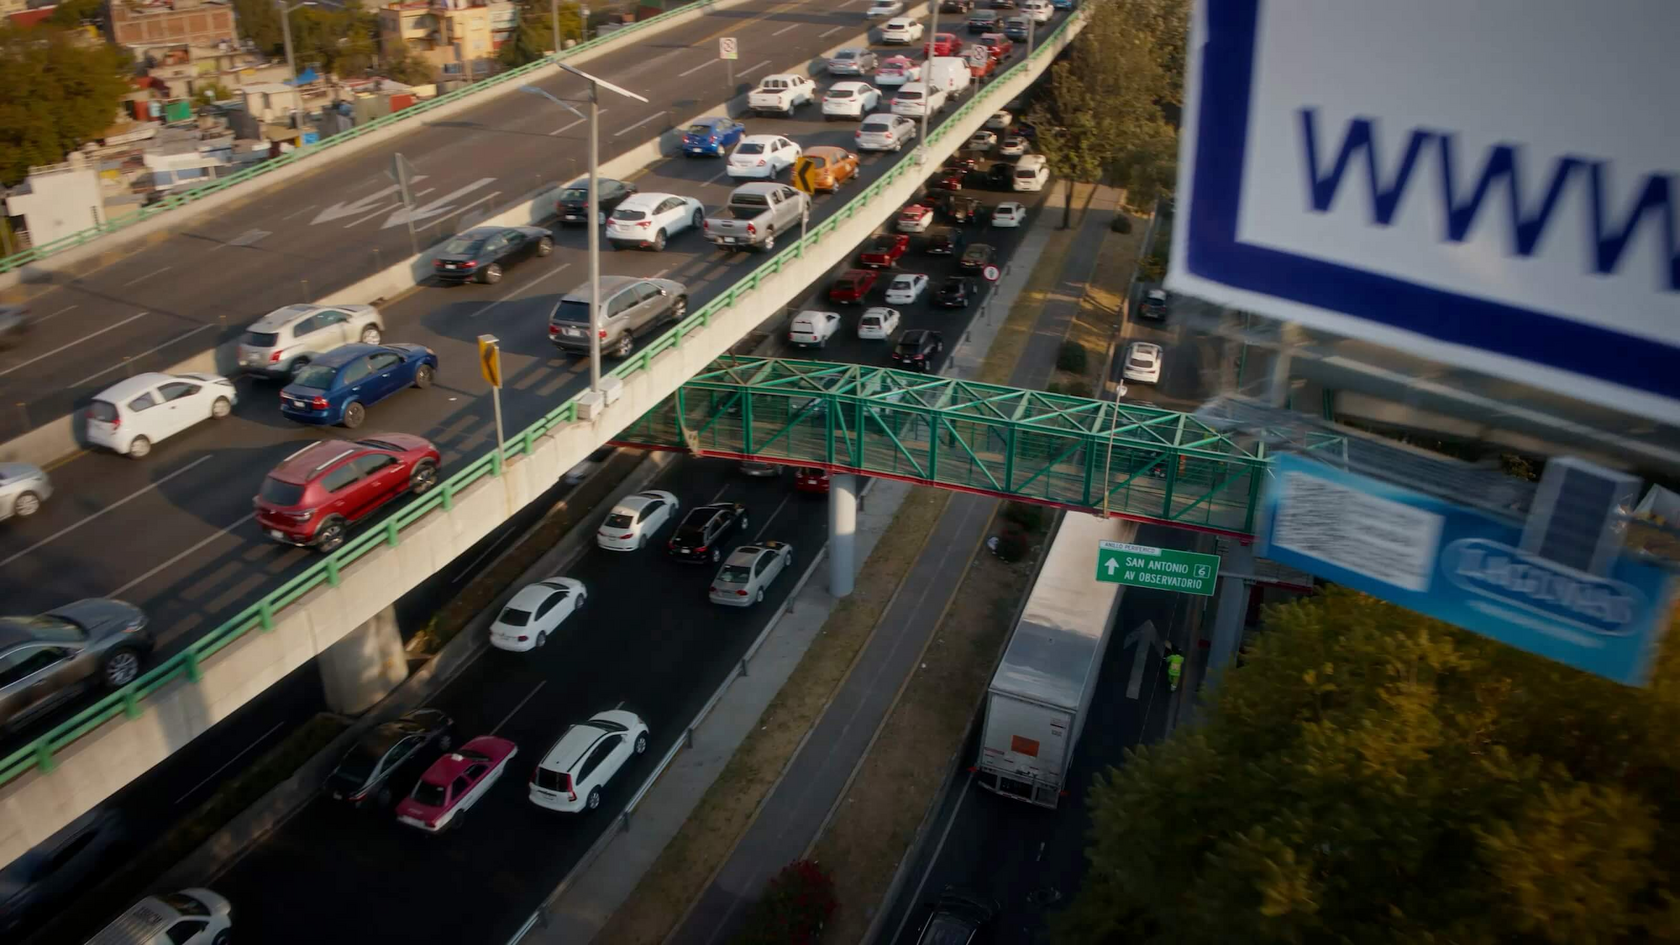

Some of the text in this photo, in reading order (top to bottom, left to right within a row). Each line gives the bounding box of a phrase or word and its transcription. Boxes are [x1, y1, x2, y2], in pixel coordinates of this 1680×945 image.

[1126, 557, 1188, 574] SAN ANTONIO
[1198, 567, 1206, 576] 6
[1124, 570, 1202, 588] AV OBSERVATORIO
